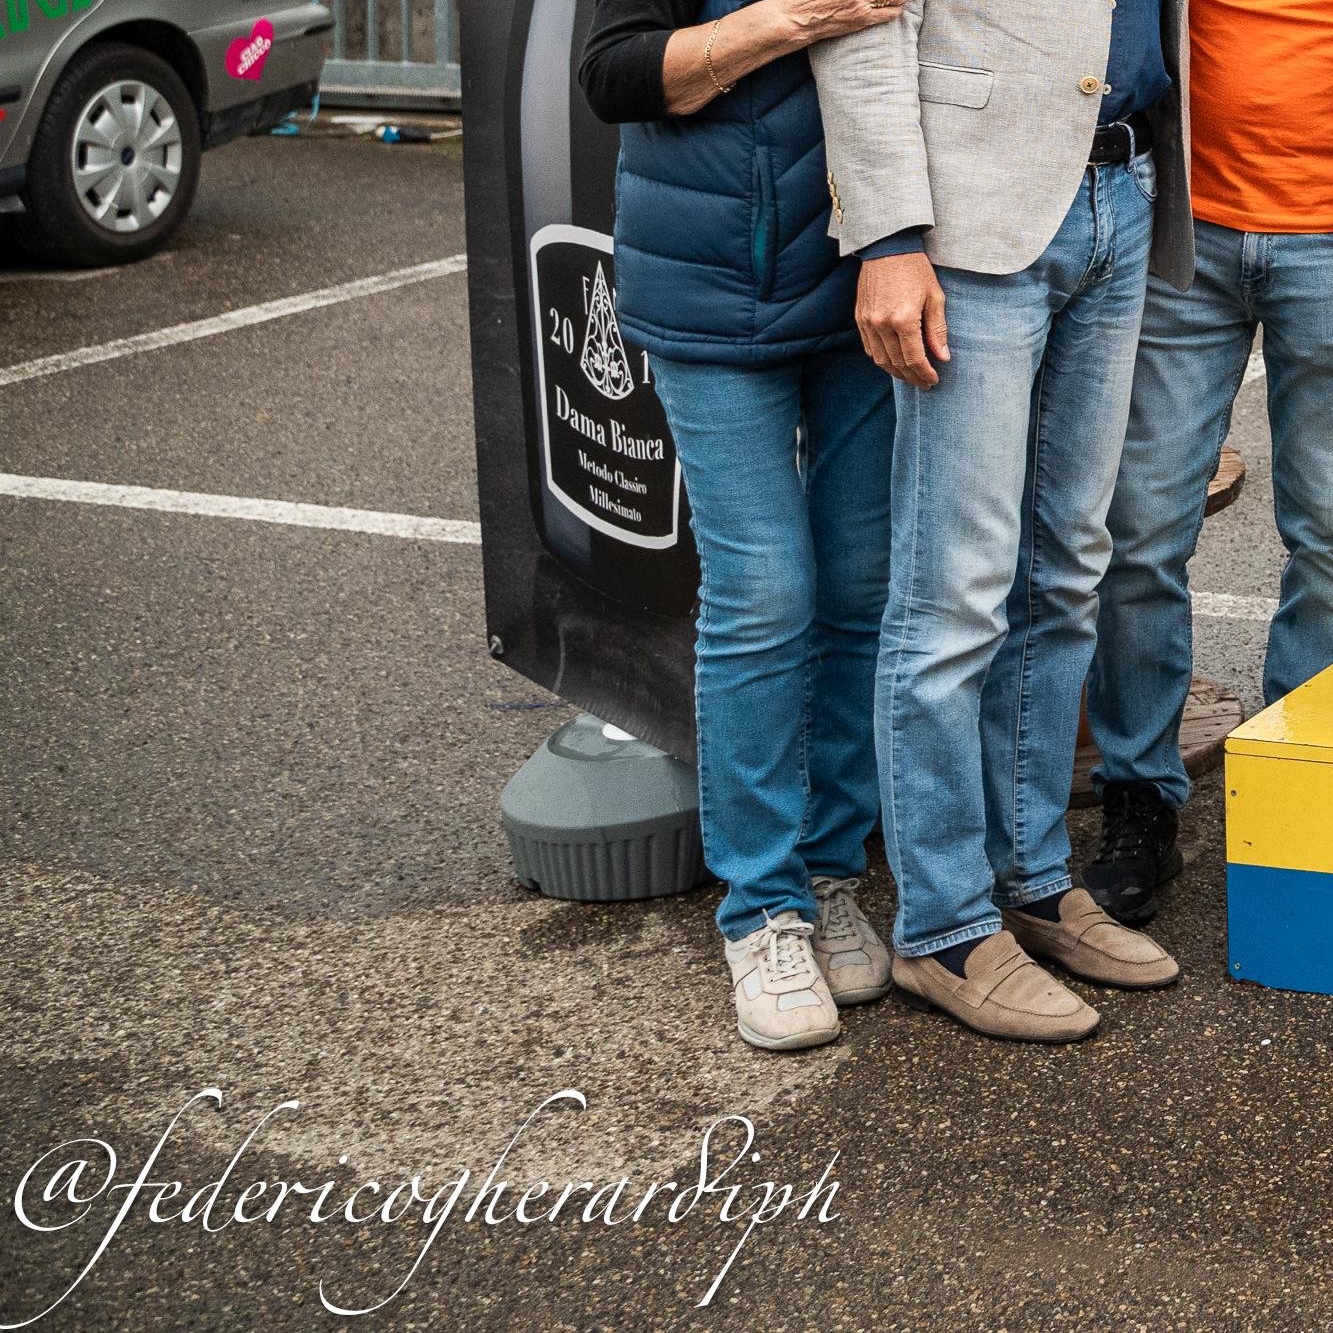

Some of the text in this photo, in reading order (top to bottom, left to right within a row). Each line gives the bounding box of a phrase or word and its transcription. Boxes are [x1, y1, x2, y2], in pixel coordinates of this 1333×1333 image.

[555, 384, 664, 461] Dama Bianca
[578, 449, 648, 495] Metodo Classico
[589, 485, 642, 523] Millesimato
